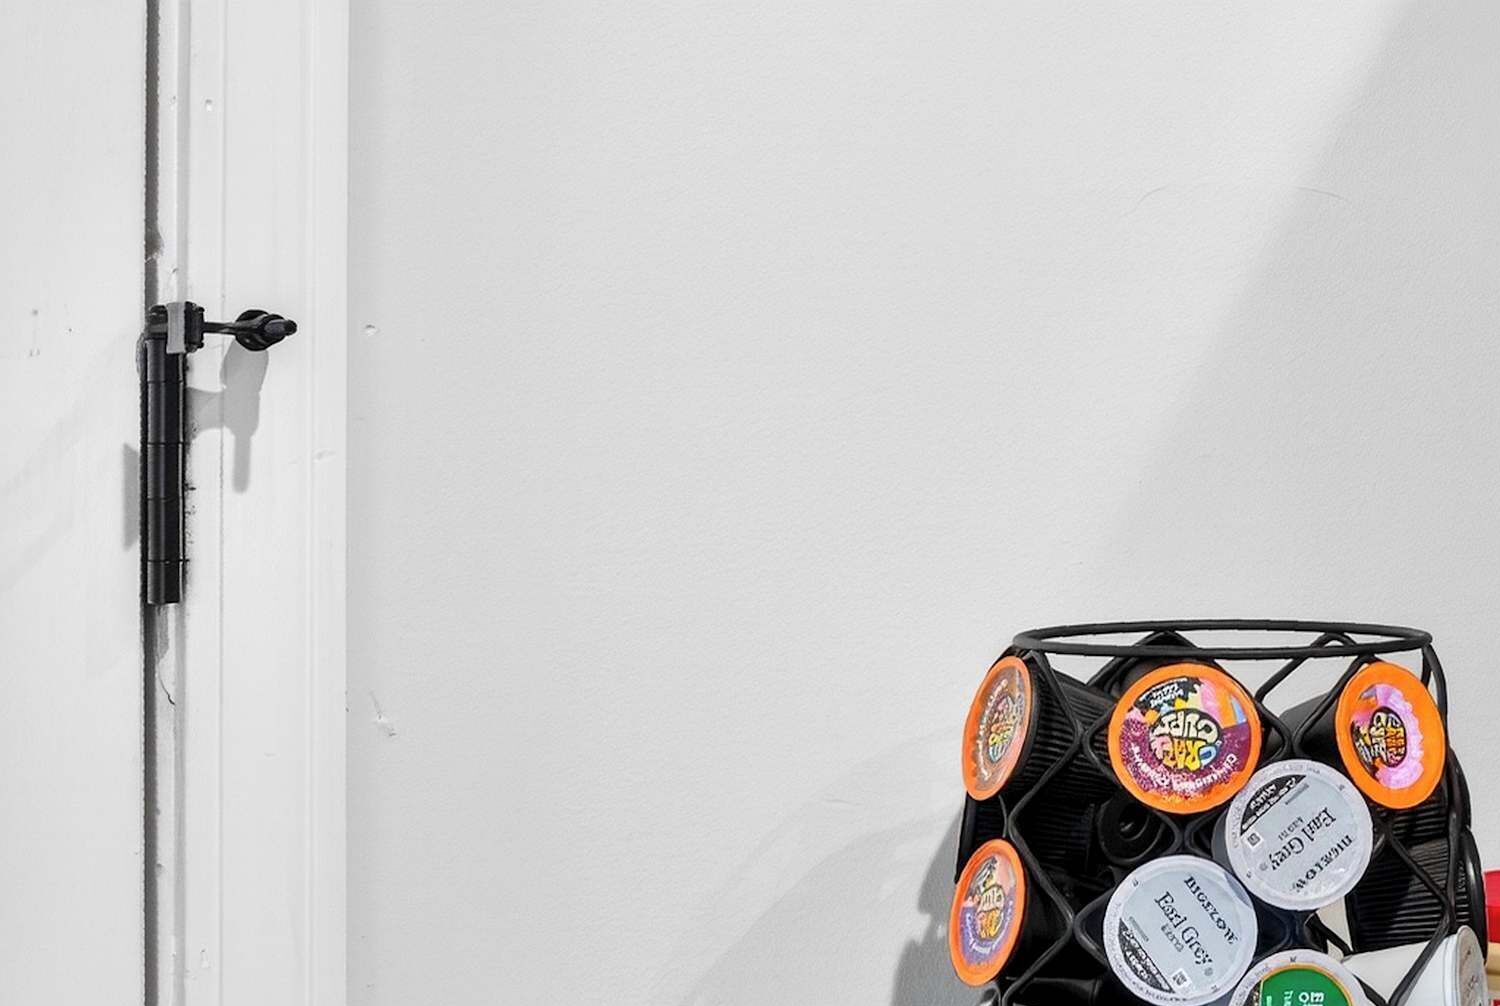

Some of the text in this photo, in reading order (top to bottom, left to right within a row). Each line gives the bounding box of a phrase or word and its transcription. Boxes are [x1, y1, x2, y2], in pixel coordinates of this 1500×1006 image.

[1302, 807, 1336, 842] Earl
[1268, 836, 1305, 871] Grey
[1154, 891, 1188, 928] Earl
[1181, 926, 1213, 965] Grey
